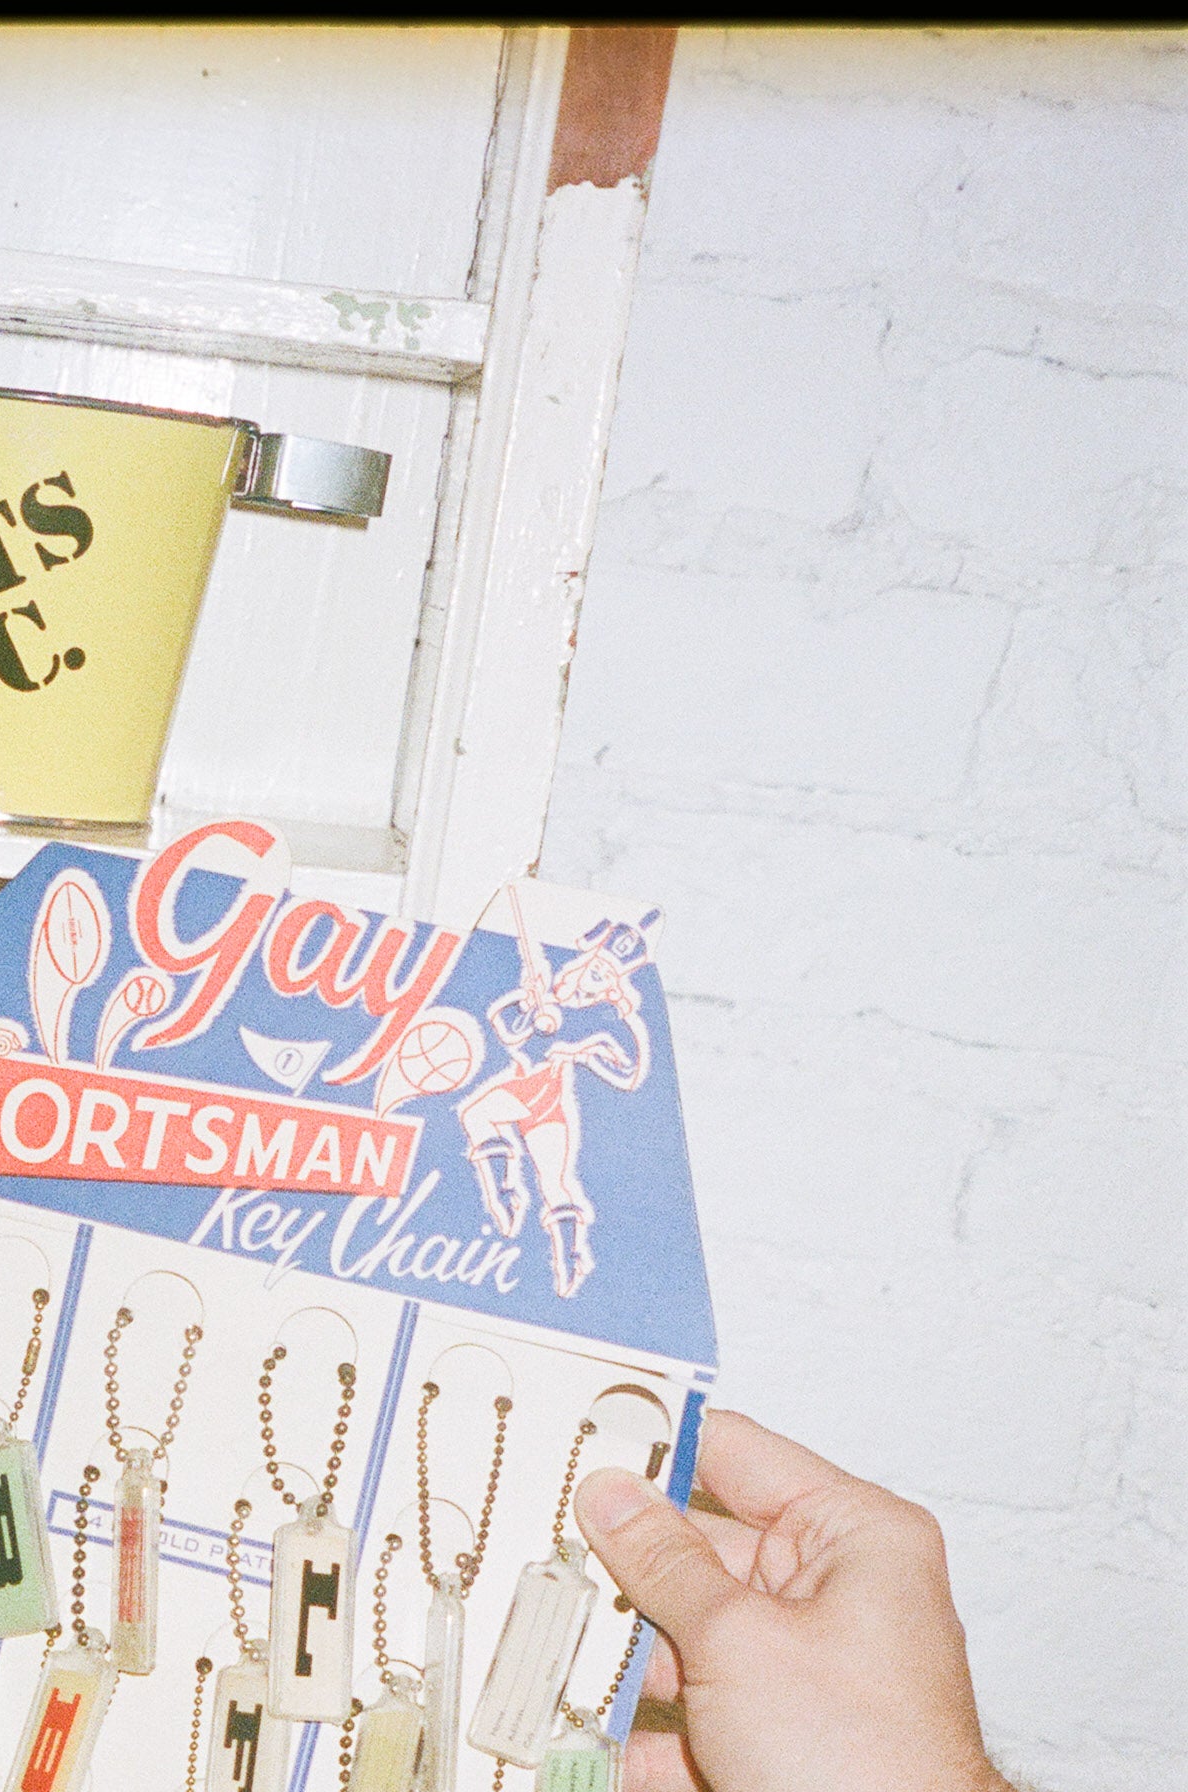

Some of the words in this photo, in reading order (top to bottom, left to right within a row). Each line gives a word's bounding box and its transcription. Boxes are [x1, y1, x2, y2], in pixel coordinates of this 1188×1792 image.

[134, 820, 464, 1088] Gay
[187, 1187, 326, 1291] Key
[329, 1169, 523, 1294] Chain
